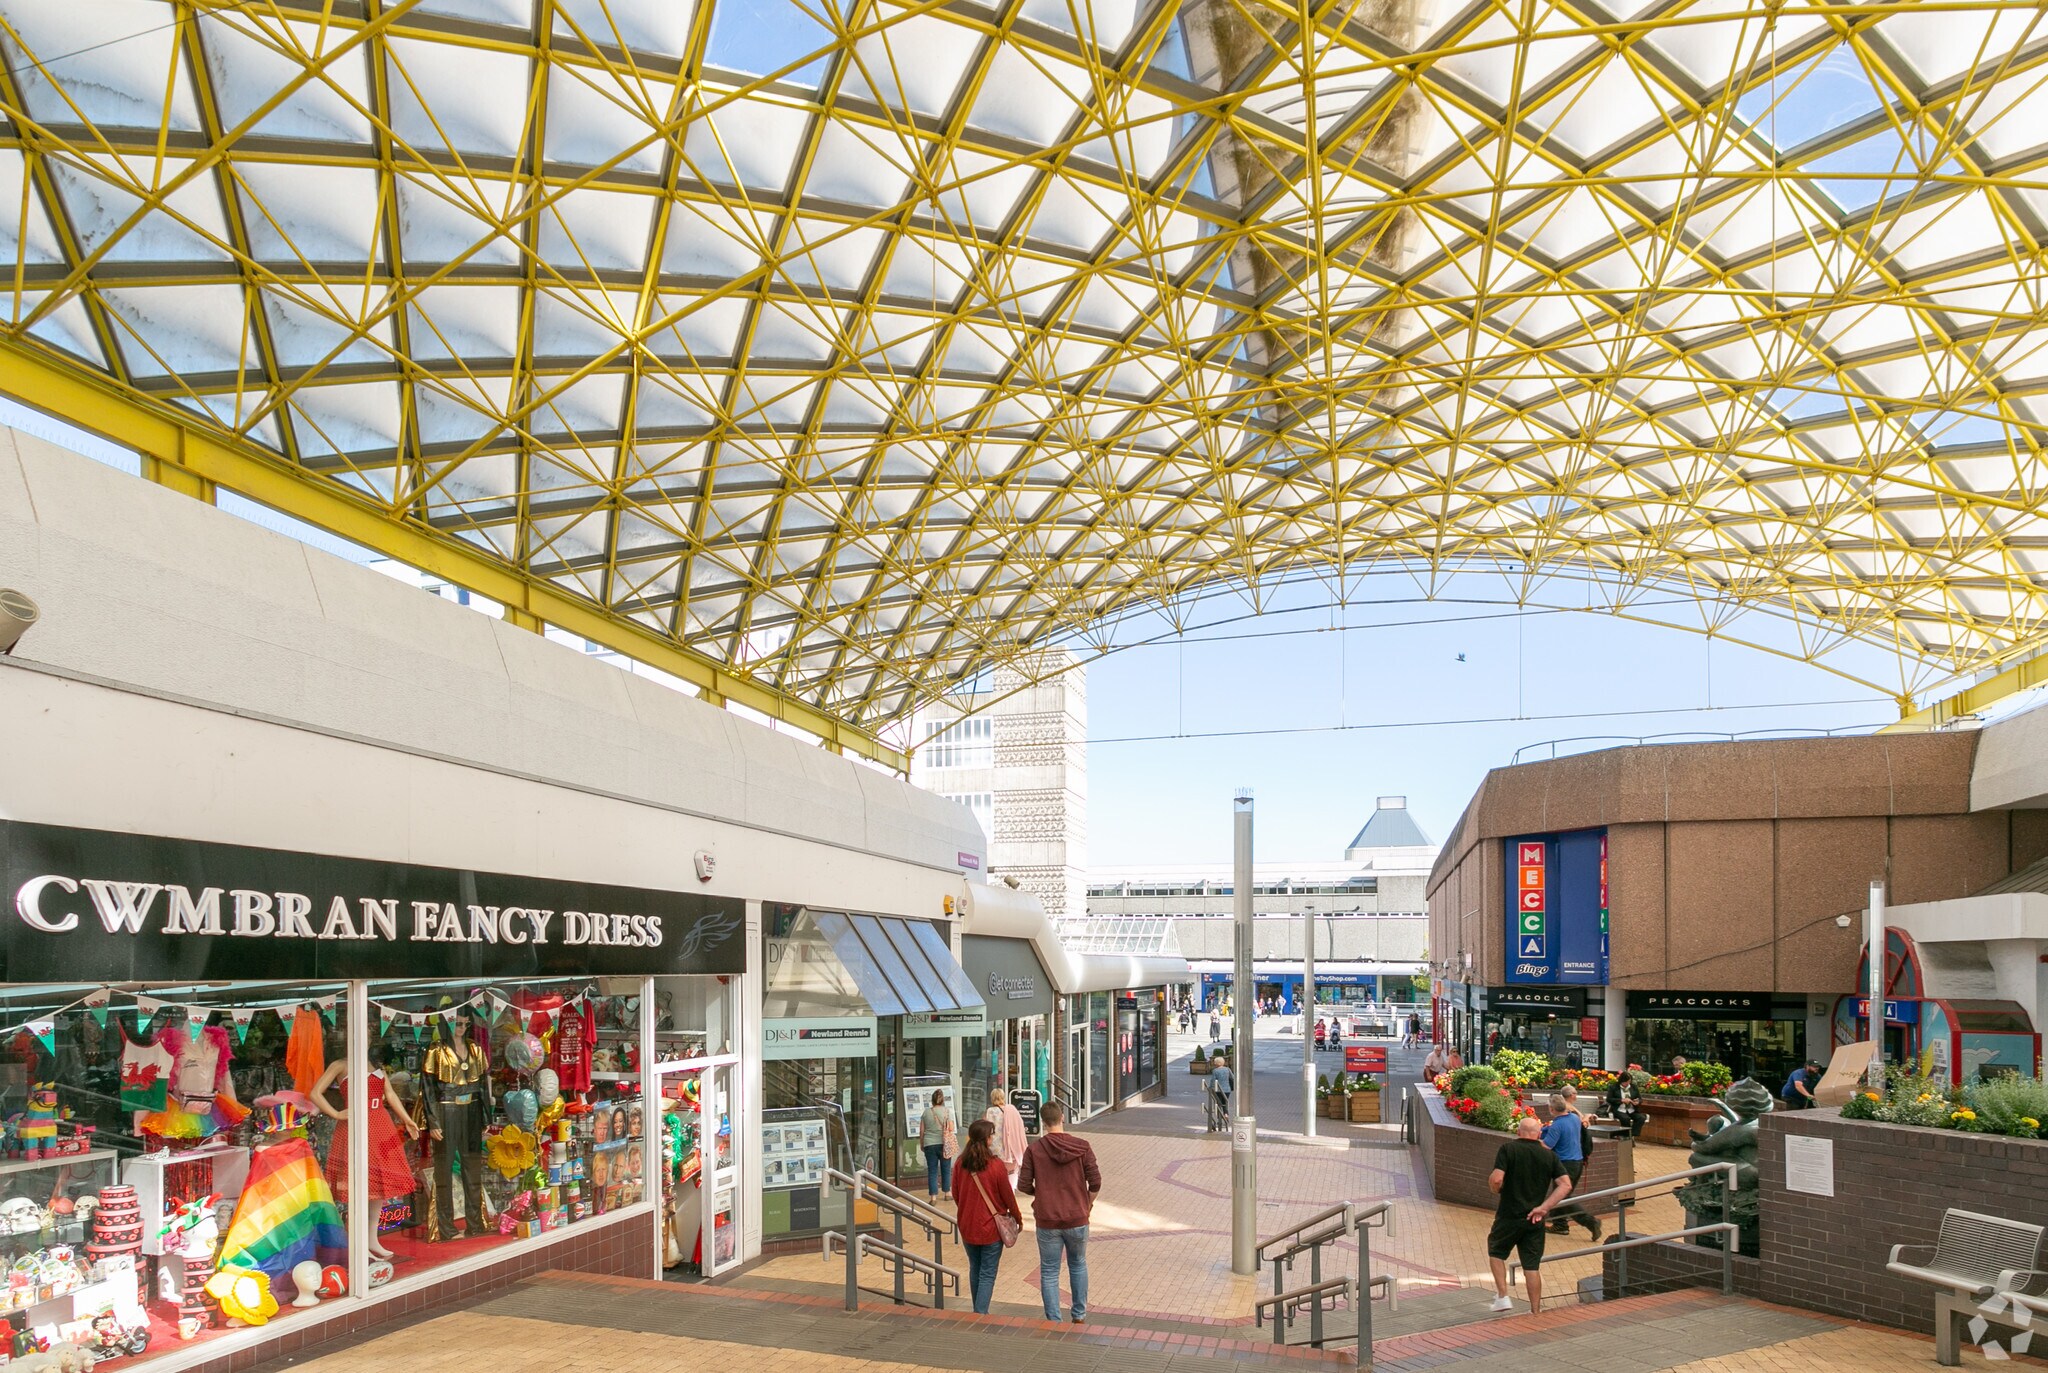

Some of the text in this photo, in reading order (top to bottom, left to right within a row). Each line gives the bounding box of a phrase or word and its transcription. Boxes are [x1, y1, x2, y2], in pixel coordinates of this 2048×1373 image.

[1524, 847, 1541, 953] MECCA
[15, 874, 663, 948] CWMBRAN FANCY DRESS
[1516, 962, 1549, 977] Bingo
[1499, 993, 1570, 1002] PEACOCKS
[1649, 997, 1751, 1006] PEACOCKS
[1858, 1003, 1893, 1016] MEA
[765, 1028, 869, 1043] DJ&P Newland Rennie
